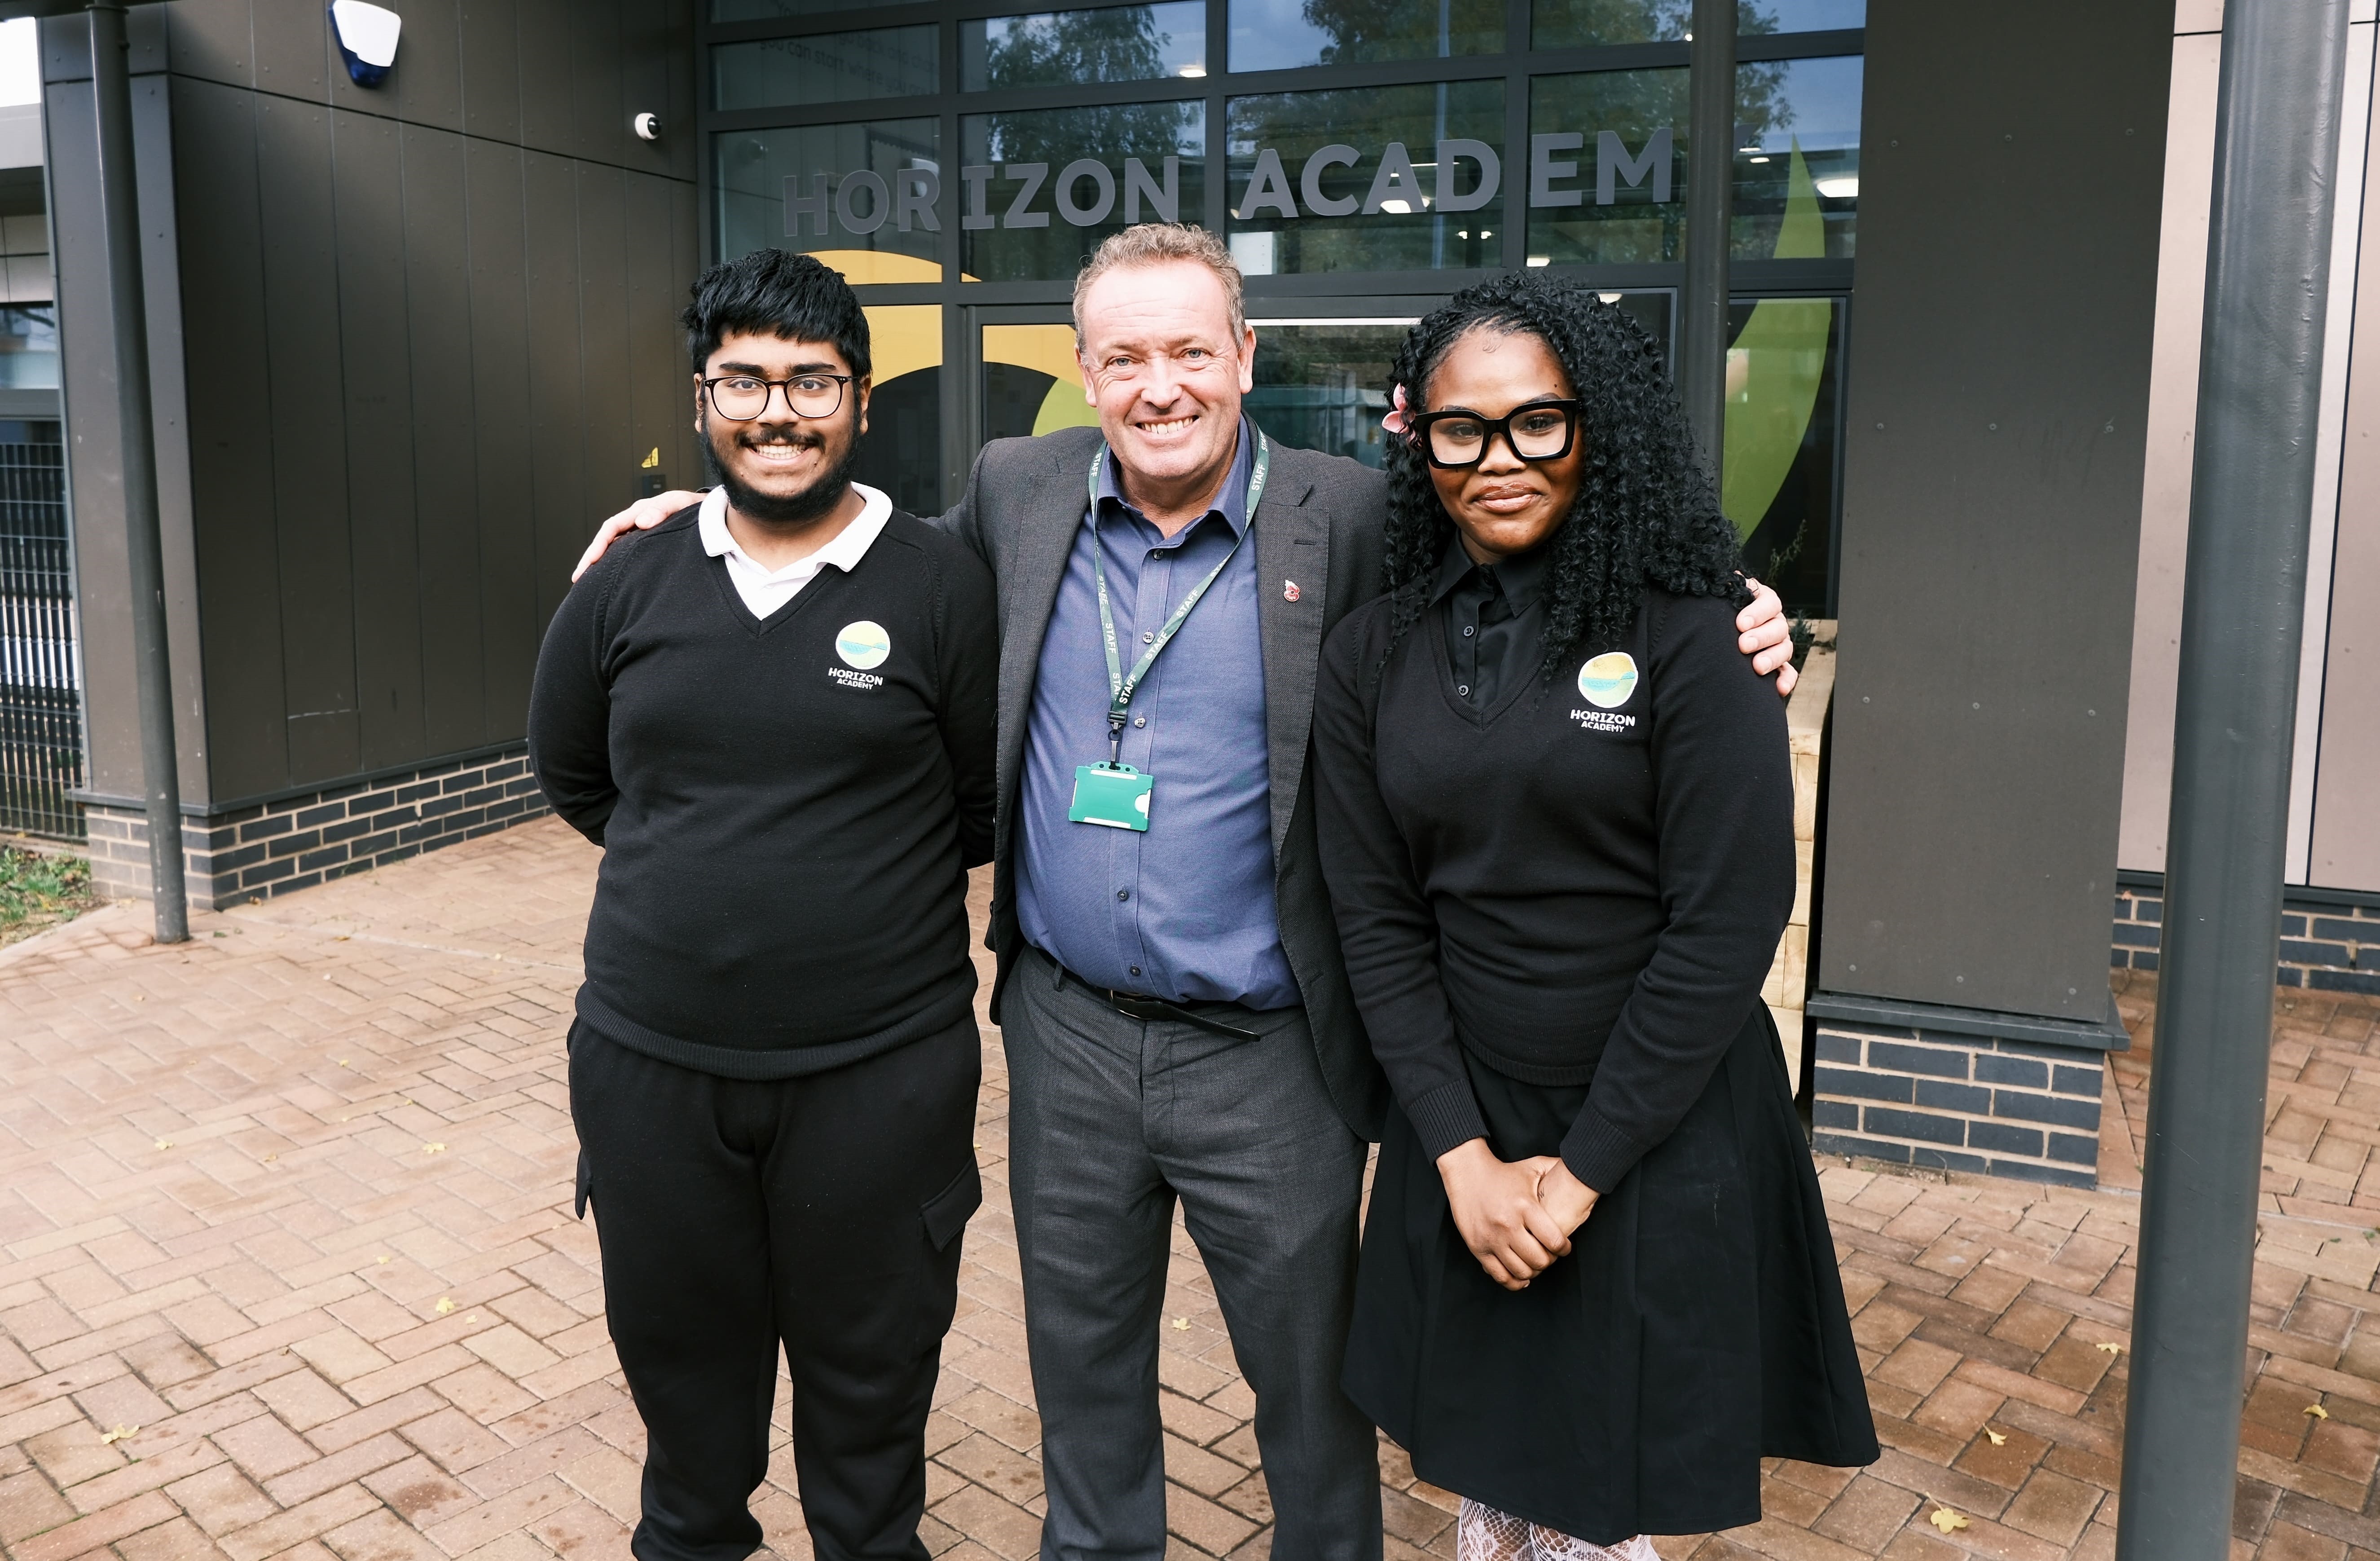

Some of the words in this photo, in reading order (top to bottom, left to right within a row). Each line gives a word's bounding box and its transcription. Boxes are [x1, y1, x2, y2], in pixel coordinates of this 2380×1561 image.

[783, 156, 1179, 237] HORIZON
[1091, 452, 1102, 477] STAFF
[1251, 463, 1265, 491] STAFF
[1099, 575, 1109, 605] STAFF
[1176, 589, 1198, 617] STAFF
[1105, 622, 1117, 654] STAFF
[1145, 631, 1168, 659] STAFF
[828, 667, 884, 686] HORIZON
[836, 678, 874, 690] ACADEMY
[1113, 673, 1121, 701] STA
[1119, 674, 1136, 704] STAFF
[1570, 709, 1636, 727] HORIZON
[1581, 720, 1624, 732] ACADEMY
